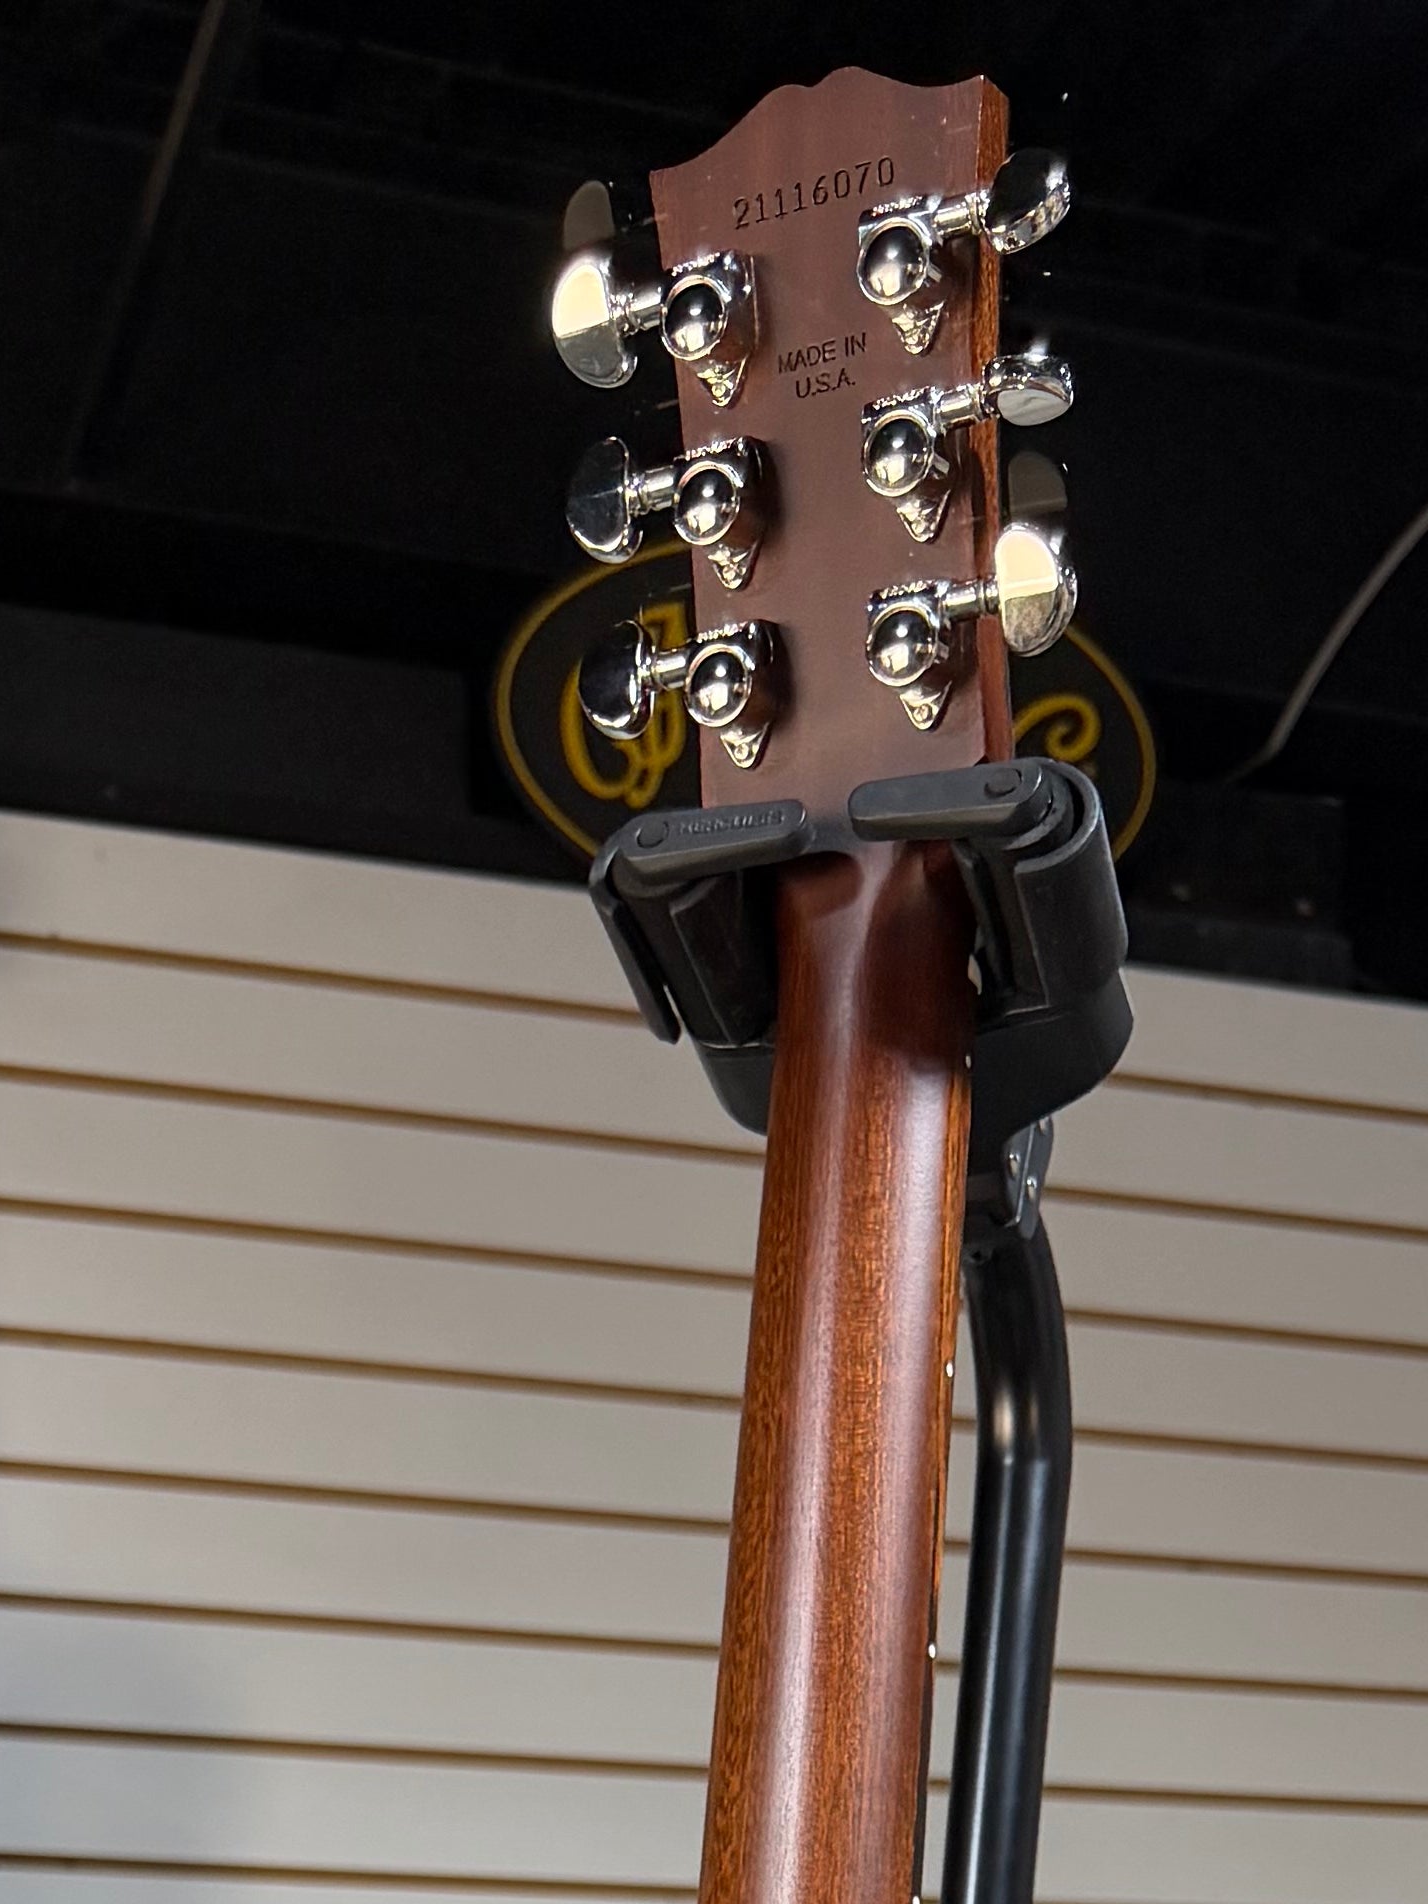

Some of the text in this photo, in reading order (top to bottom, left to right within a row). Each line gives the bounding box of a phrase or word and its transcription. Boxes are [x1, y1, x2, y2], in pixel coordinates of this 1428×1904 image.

[733, 156, 895, 231] 21116070
[777, 331, 867, 375] MADE IN
[795, 367, 856, 399] U.S.A.
